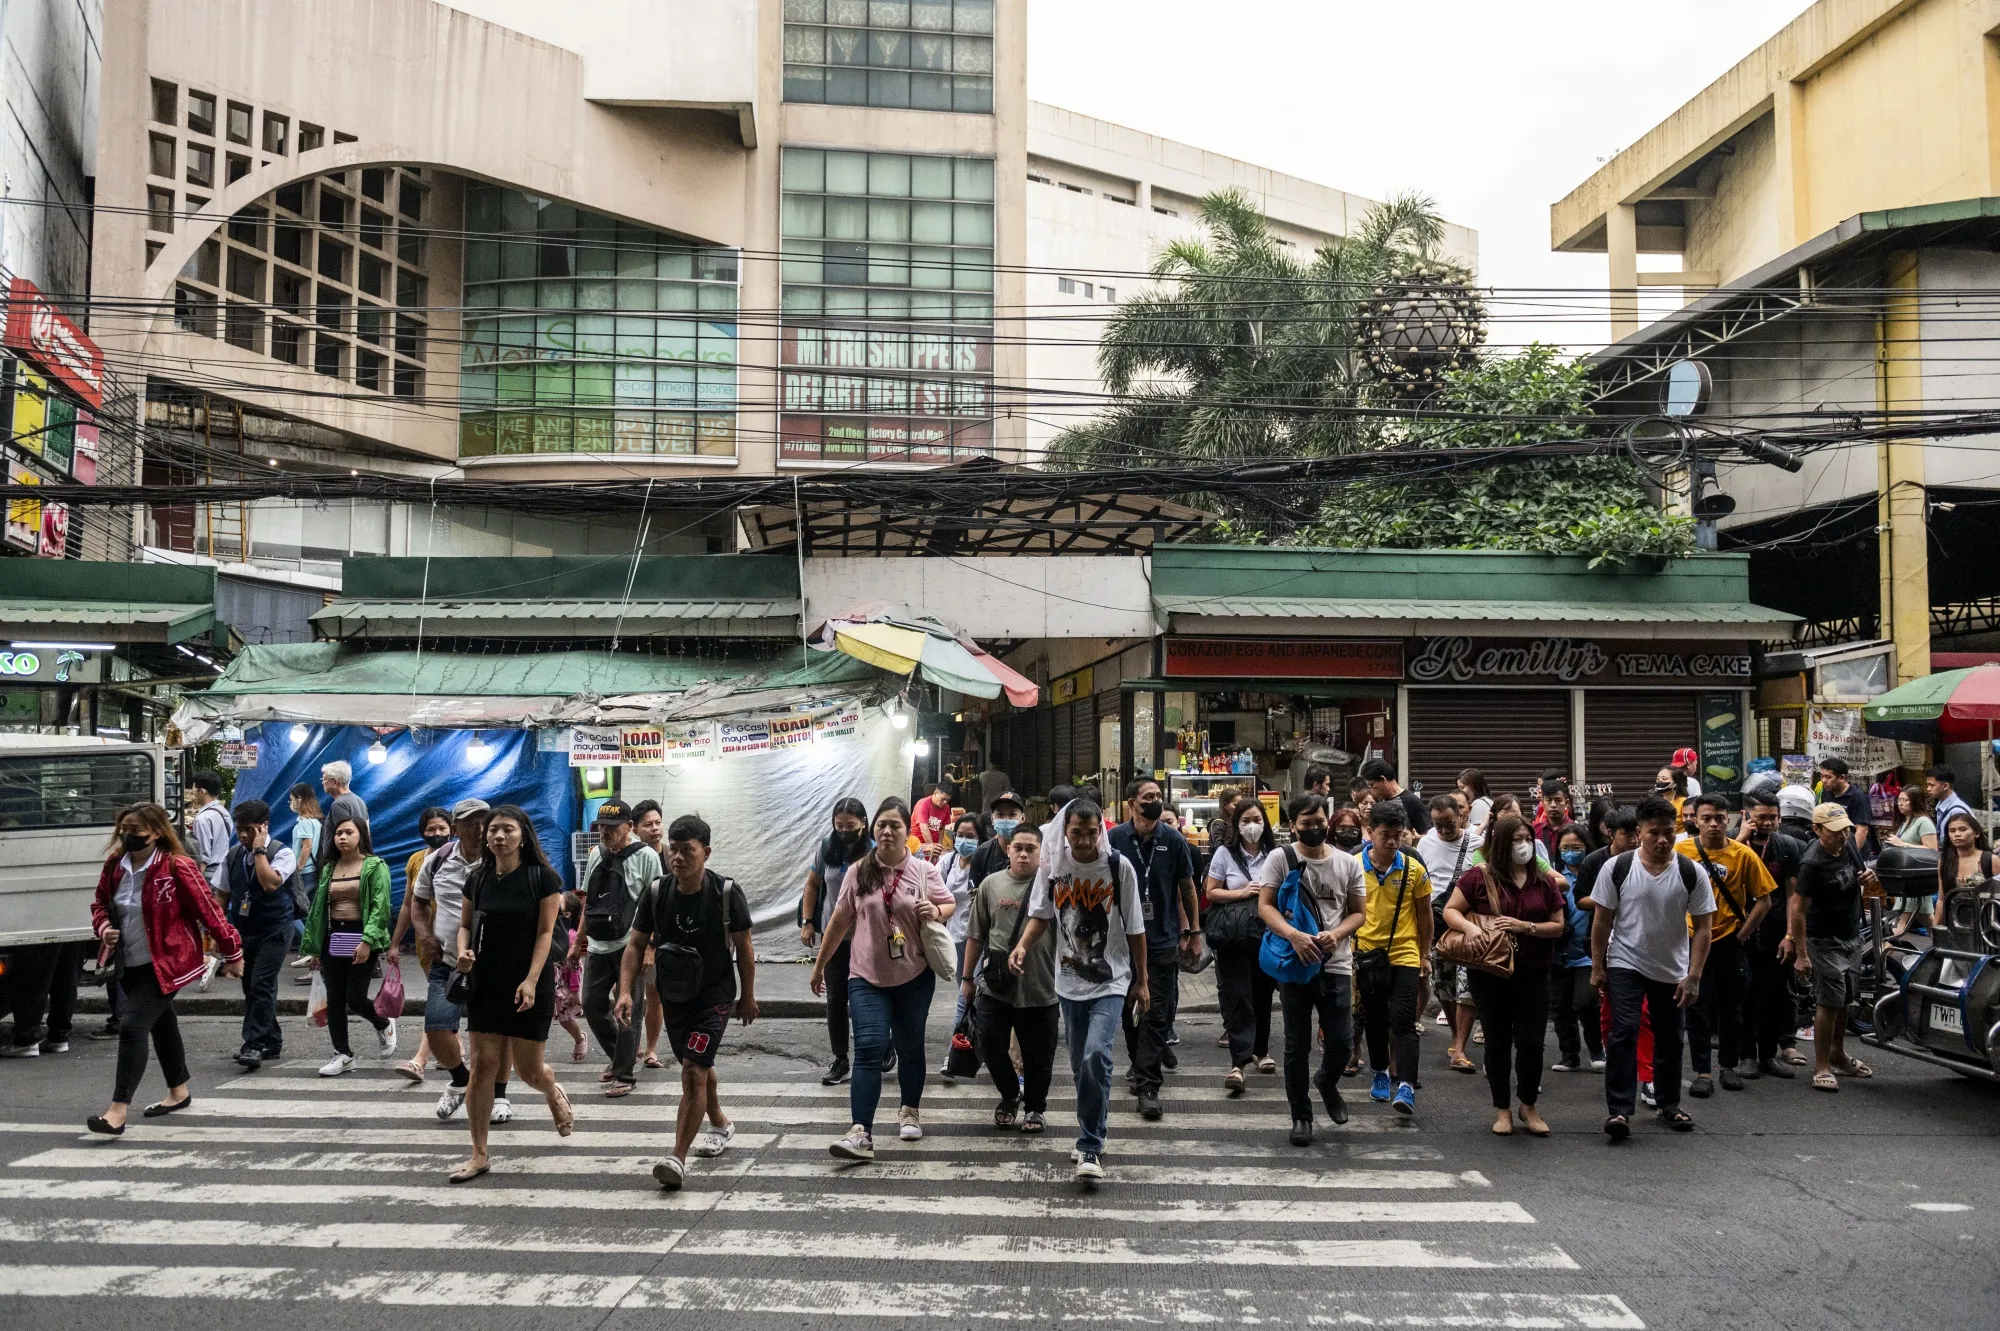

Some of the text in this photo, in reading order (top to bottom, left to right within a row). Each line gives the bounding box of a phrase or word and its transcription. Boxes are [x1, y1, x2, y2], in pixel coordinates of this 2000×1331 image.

[697, 383, 732, 395] Store
[785, 374, 985, 416] DEPARTMENT STORE
[474, 418, 729, 436] COME AND SHOP WITH US
[828, 426, 844, 438] 2nd
[845, 427, 865, 439] floor
[866, 427, 895, 440] Victory
[926, 429, 944, 441] Mall
[501, 436, 694, 453] AT THE 2ND LEVEL
[804, 441, 822, 452] Riza
[825, 441, 840, 452] Ave
[1168, 642, 1232, 656] CORAZON
[1235, 643, 1263, 657] EGG
[1268, 643, 1294, 657] AND
[1299, 644, 1364, 658] JAPANESE
[1616, 653, 1751, 676] YEMA CAKE
[841, 714, 859, 723] DITO
[736, 722, 768, 733] GCash
[772, 719, 810, 734] LOAD
[835, 727, 855, 737] WALLET
[589, 734, 619, 742] GCash
[623, 732, 661, 747] LOAD
[721, 734, 748, 744] maya
[773, 735, 786, 745] NA
[788, 732, 811, 744] DITO!
[1704, 739, 1740, 748] Handmade
[573, 744, 600, 752] maya
[624, 748, 662, 759] NA DITO!
[1705, 747, 1740, 757] Goodness!
[1933, 1005, 1956, 1025] TWR
